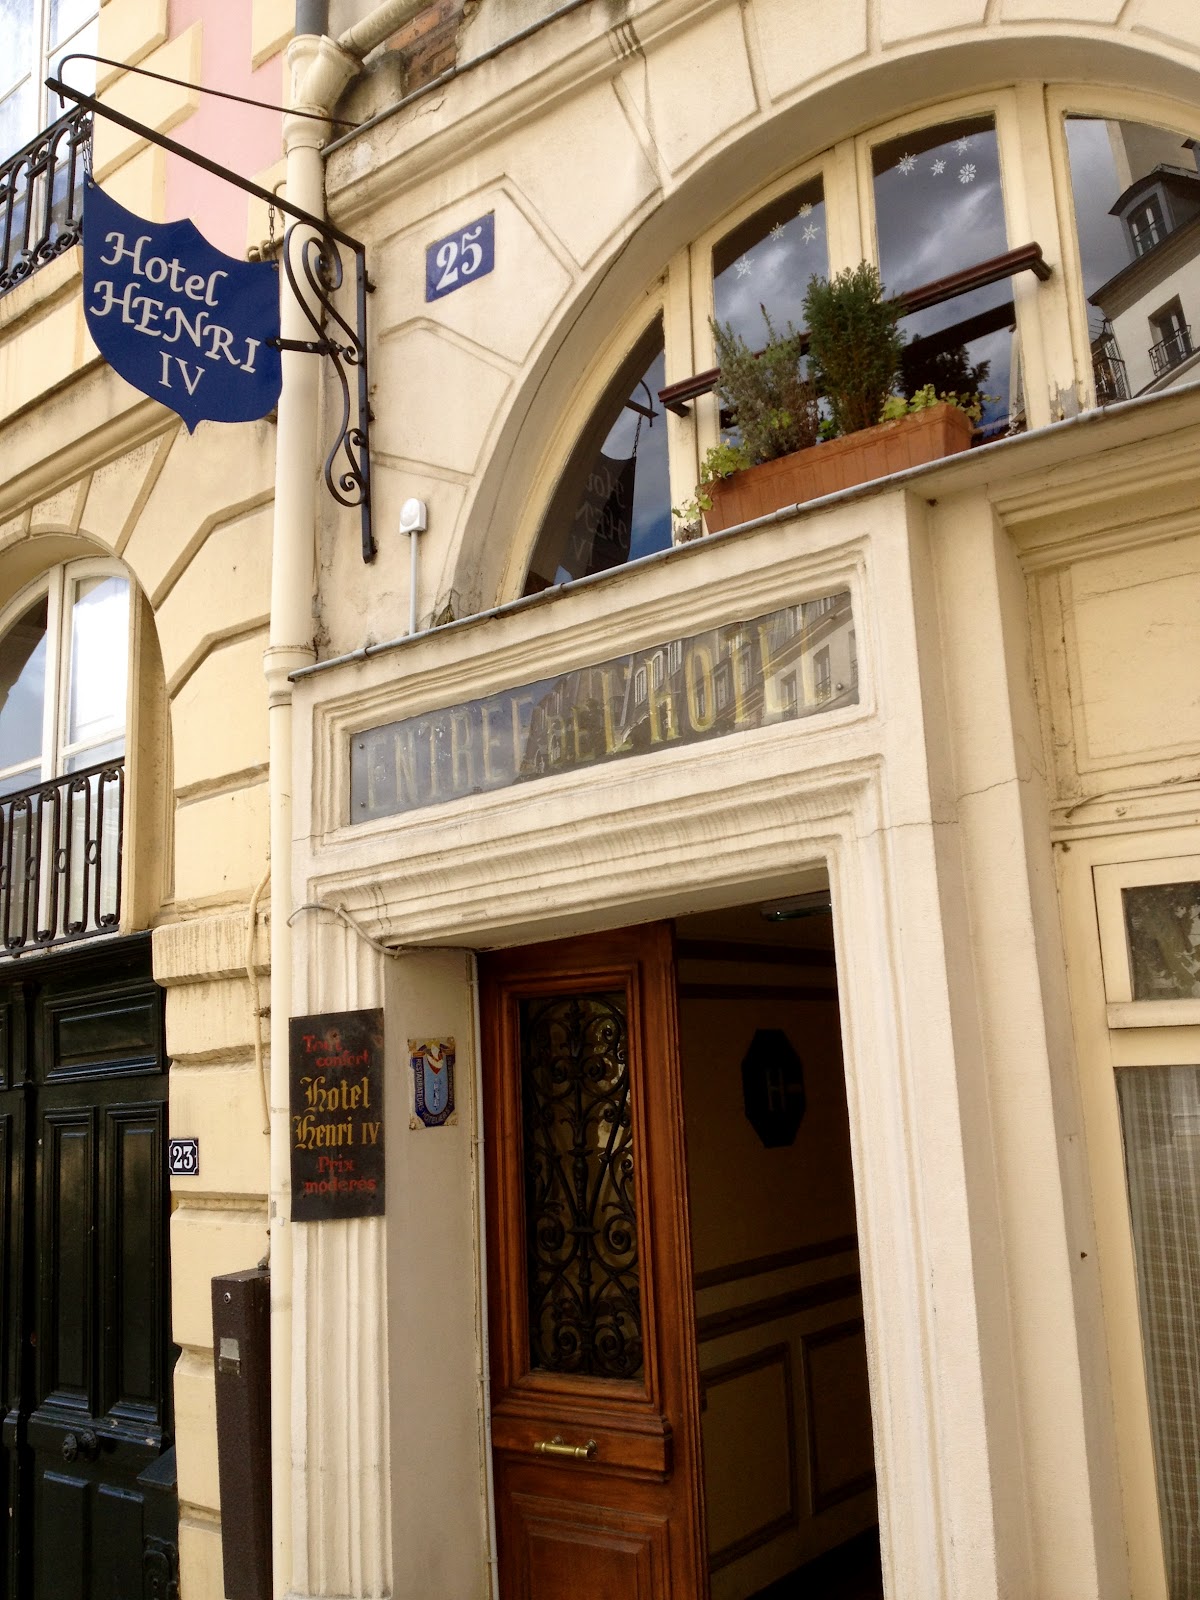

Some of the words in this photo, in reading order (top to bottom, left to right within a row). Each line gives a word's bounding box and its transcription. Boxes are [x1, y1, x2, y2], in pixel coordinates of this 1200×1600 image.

[100, 232, 229, 307] Hotel
[436, 225, 483, 291] 25
[89, 280, 261, 374] HENRI
[158, 350, 206, 396] IV
[315, 1049, 369, 1068] confort
[300, 1076, 371, 1113] Hotel
[293, 1114, 354, 1150] Henri
[361, 1122, 381, 1145] IV
[172, 1145, 194, 1169] 23
[318, 1153, 355, 1174] Prix
